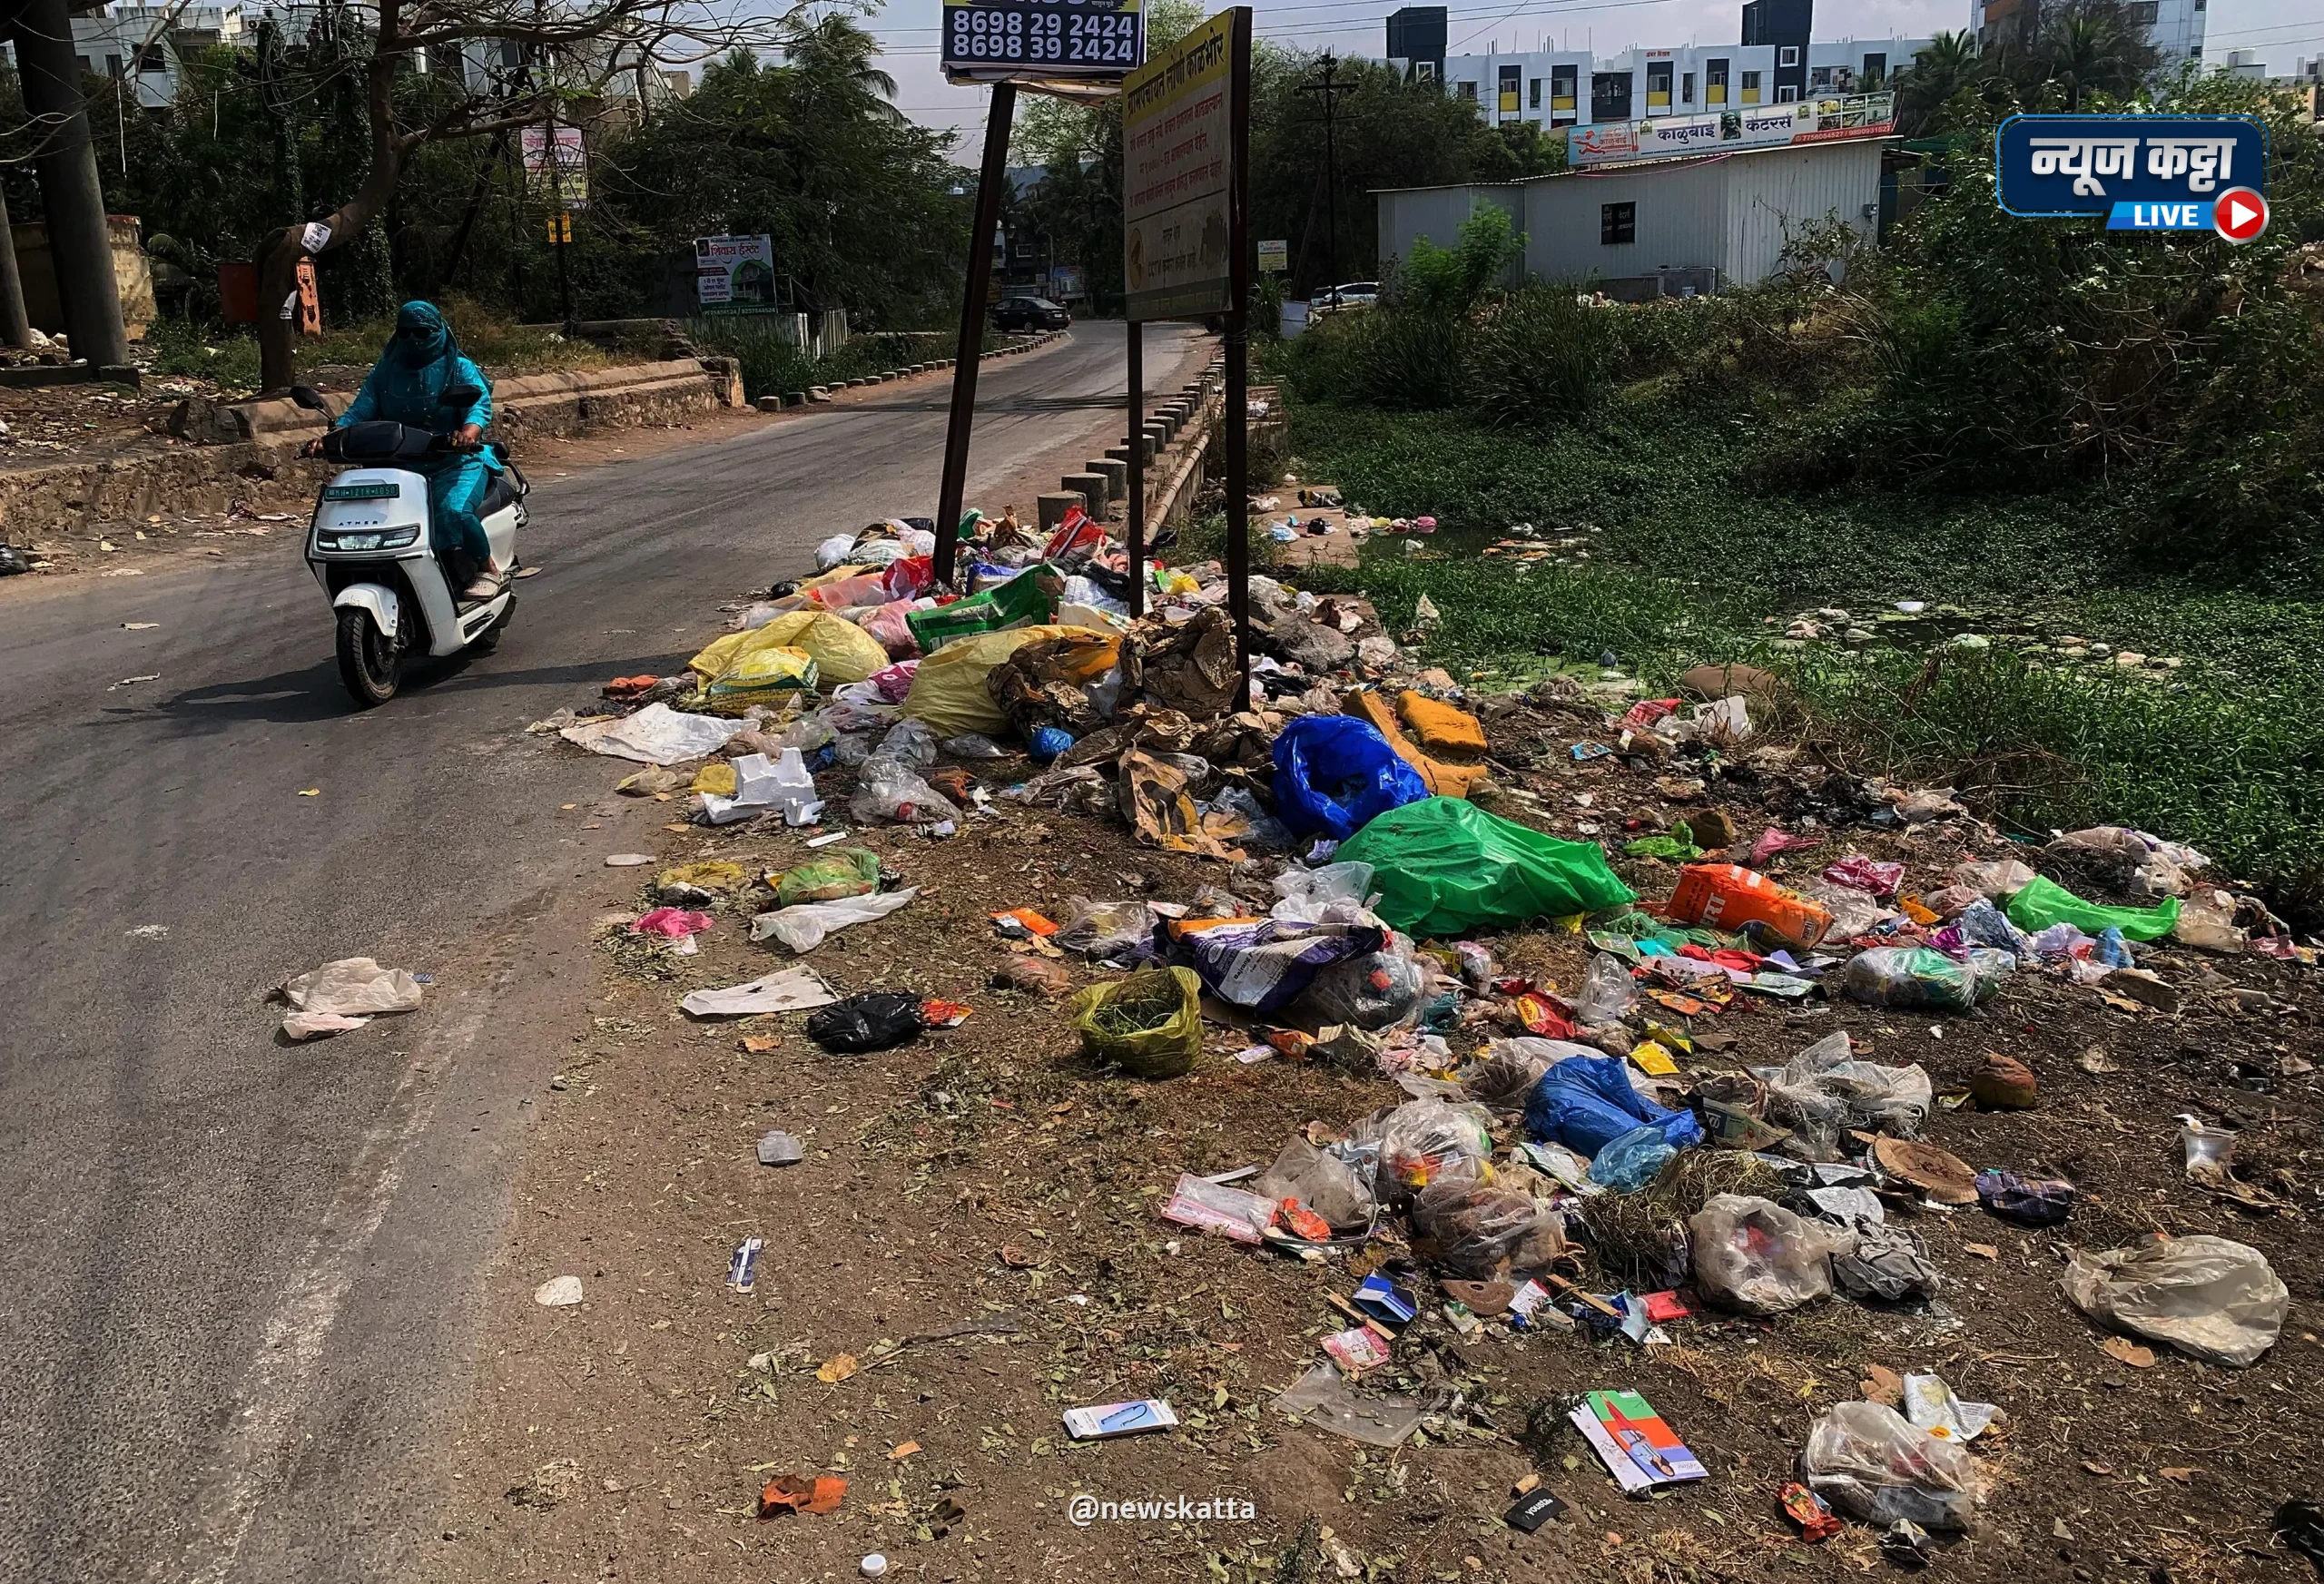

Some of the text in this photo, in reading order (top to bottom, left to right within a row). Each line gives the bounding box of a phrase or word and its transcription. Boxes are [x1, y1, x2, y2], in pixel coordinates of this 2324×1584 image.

[953, 10, 1134, 38] 8698 29 2424
[953, 34, 1134, 61] 8698 39 2424
[1128, 27, 1225, 118] ग्रामपंचायत लोणी काळभोर
[1658, 112, 1793, 144] काळुबाई केटरर्स
[1233, 952, 1252, 980] Bajrang
